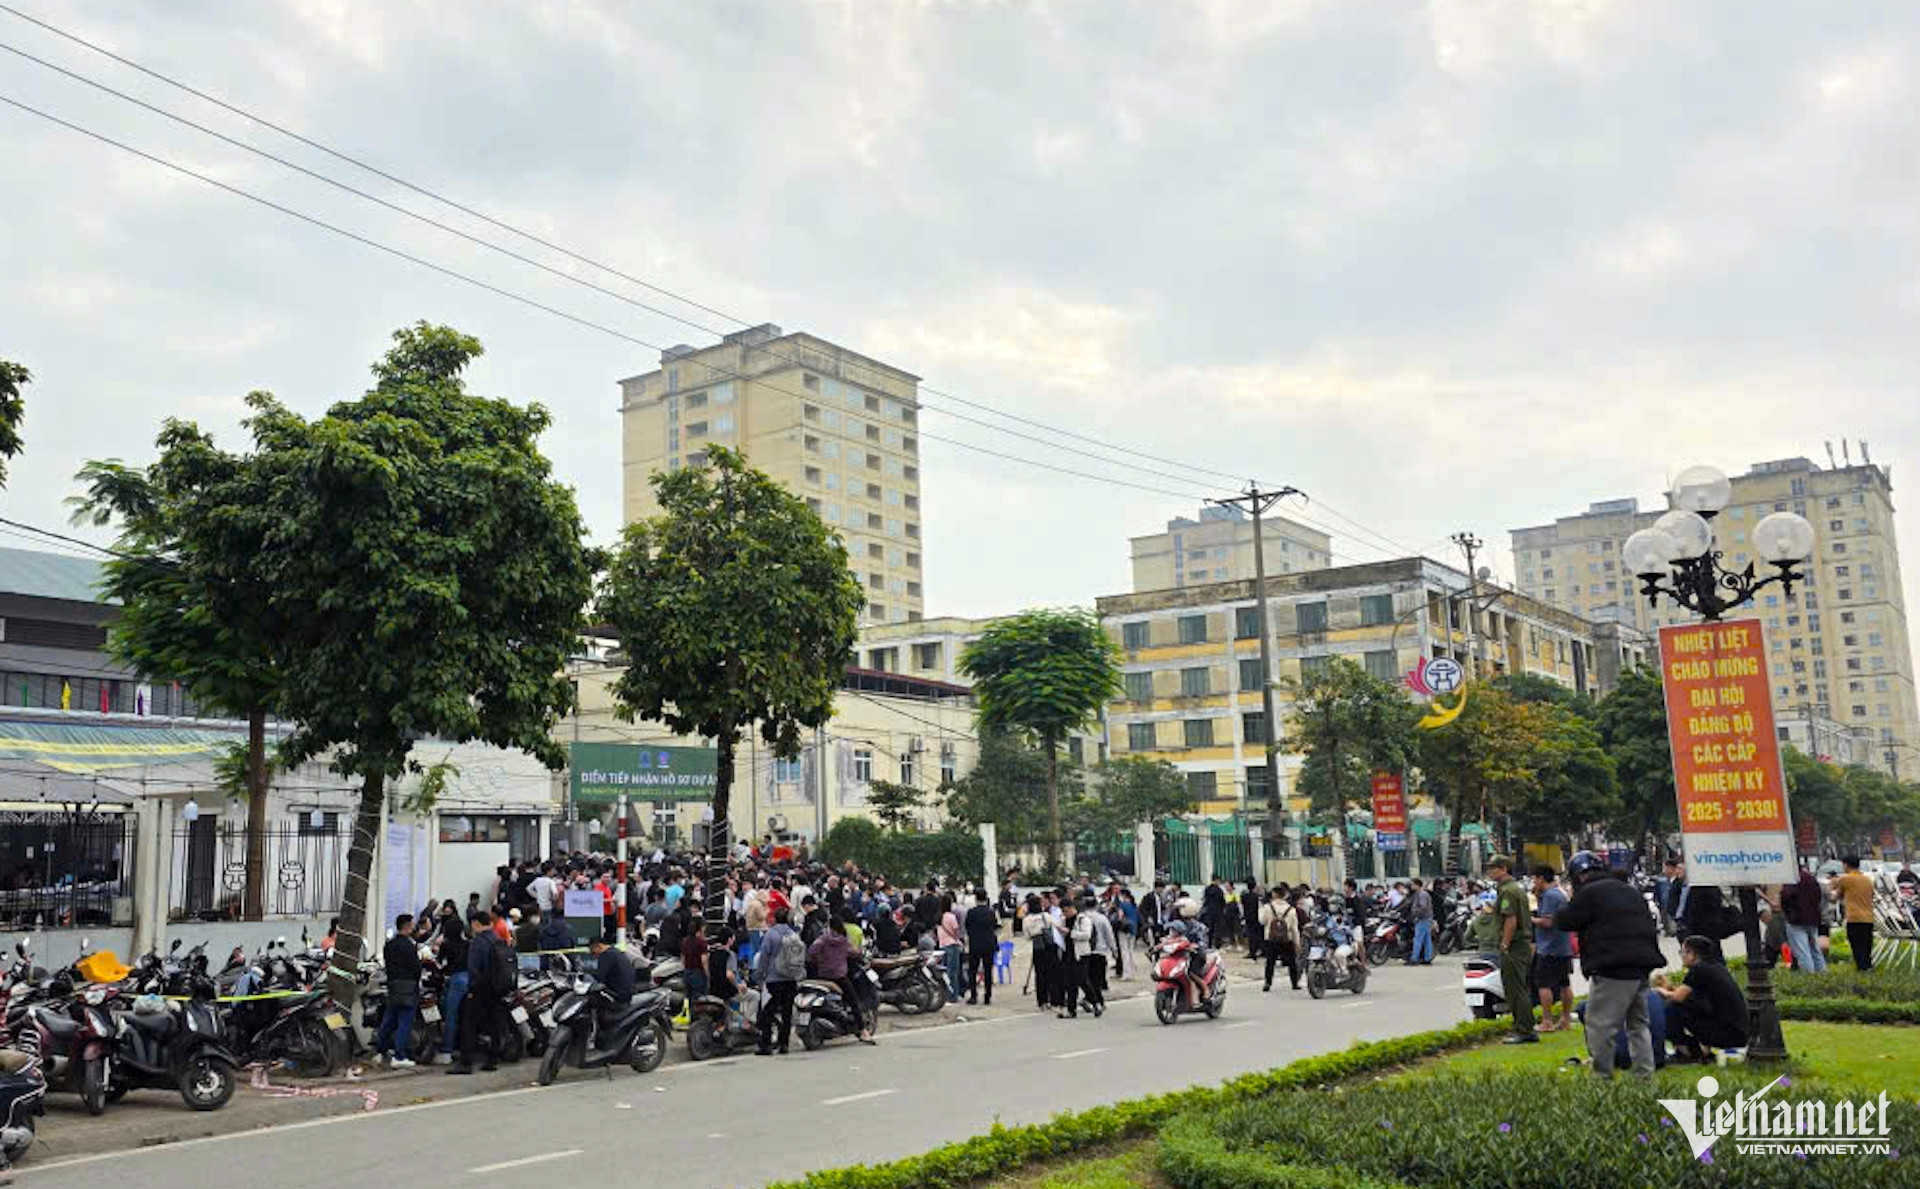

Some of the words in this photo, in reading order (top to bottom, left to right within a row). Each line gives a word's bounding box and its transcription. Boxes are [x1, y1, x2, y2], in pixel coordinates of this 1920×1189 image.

[1673, 630, 1714, 654] NHIỆT
[1719, 627, 1749, 652] LIỆT
[1671, 657, 1710, 680] CHÀO
[1714, 654, 1758, 678] MỪNG
[1690, 688, 1716, 710] ĐẠI
[1720, 682, 1745, 709] HỘI
[1689, 711, 1730, 735] ĐẢNG
[1732, 711, 1754, 736] BỘ
[1692, 740, 1723, 764] CÁC
[1726, 736, 1757, 762] CẤP
[609, 770, 630, 784] TIẾP
[1692, 769, 1741, 795] NHIỆM
[1744, 767, 1764, 791] KỲ
[1686, 801, 1722, 821] 2025
[1736, 799, 1778, 819] 2030!
[1694, 849, 1784, 866] vinaphone
